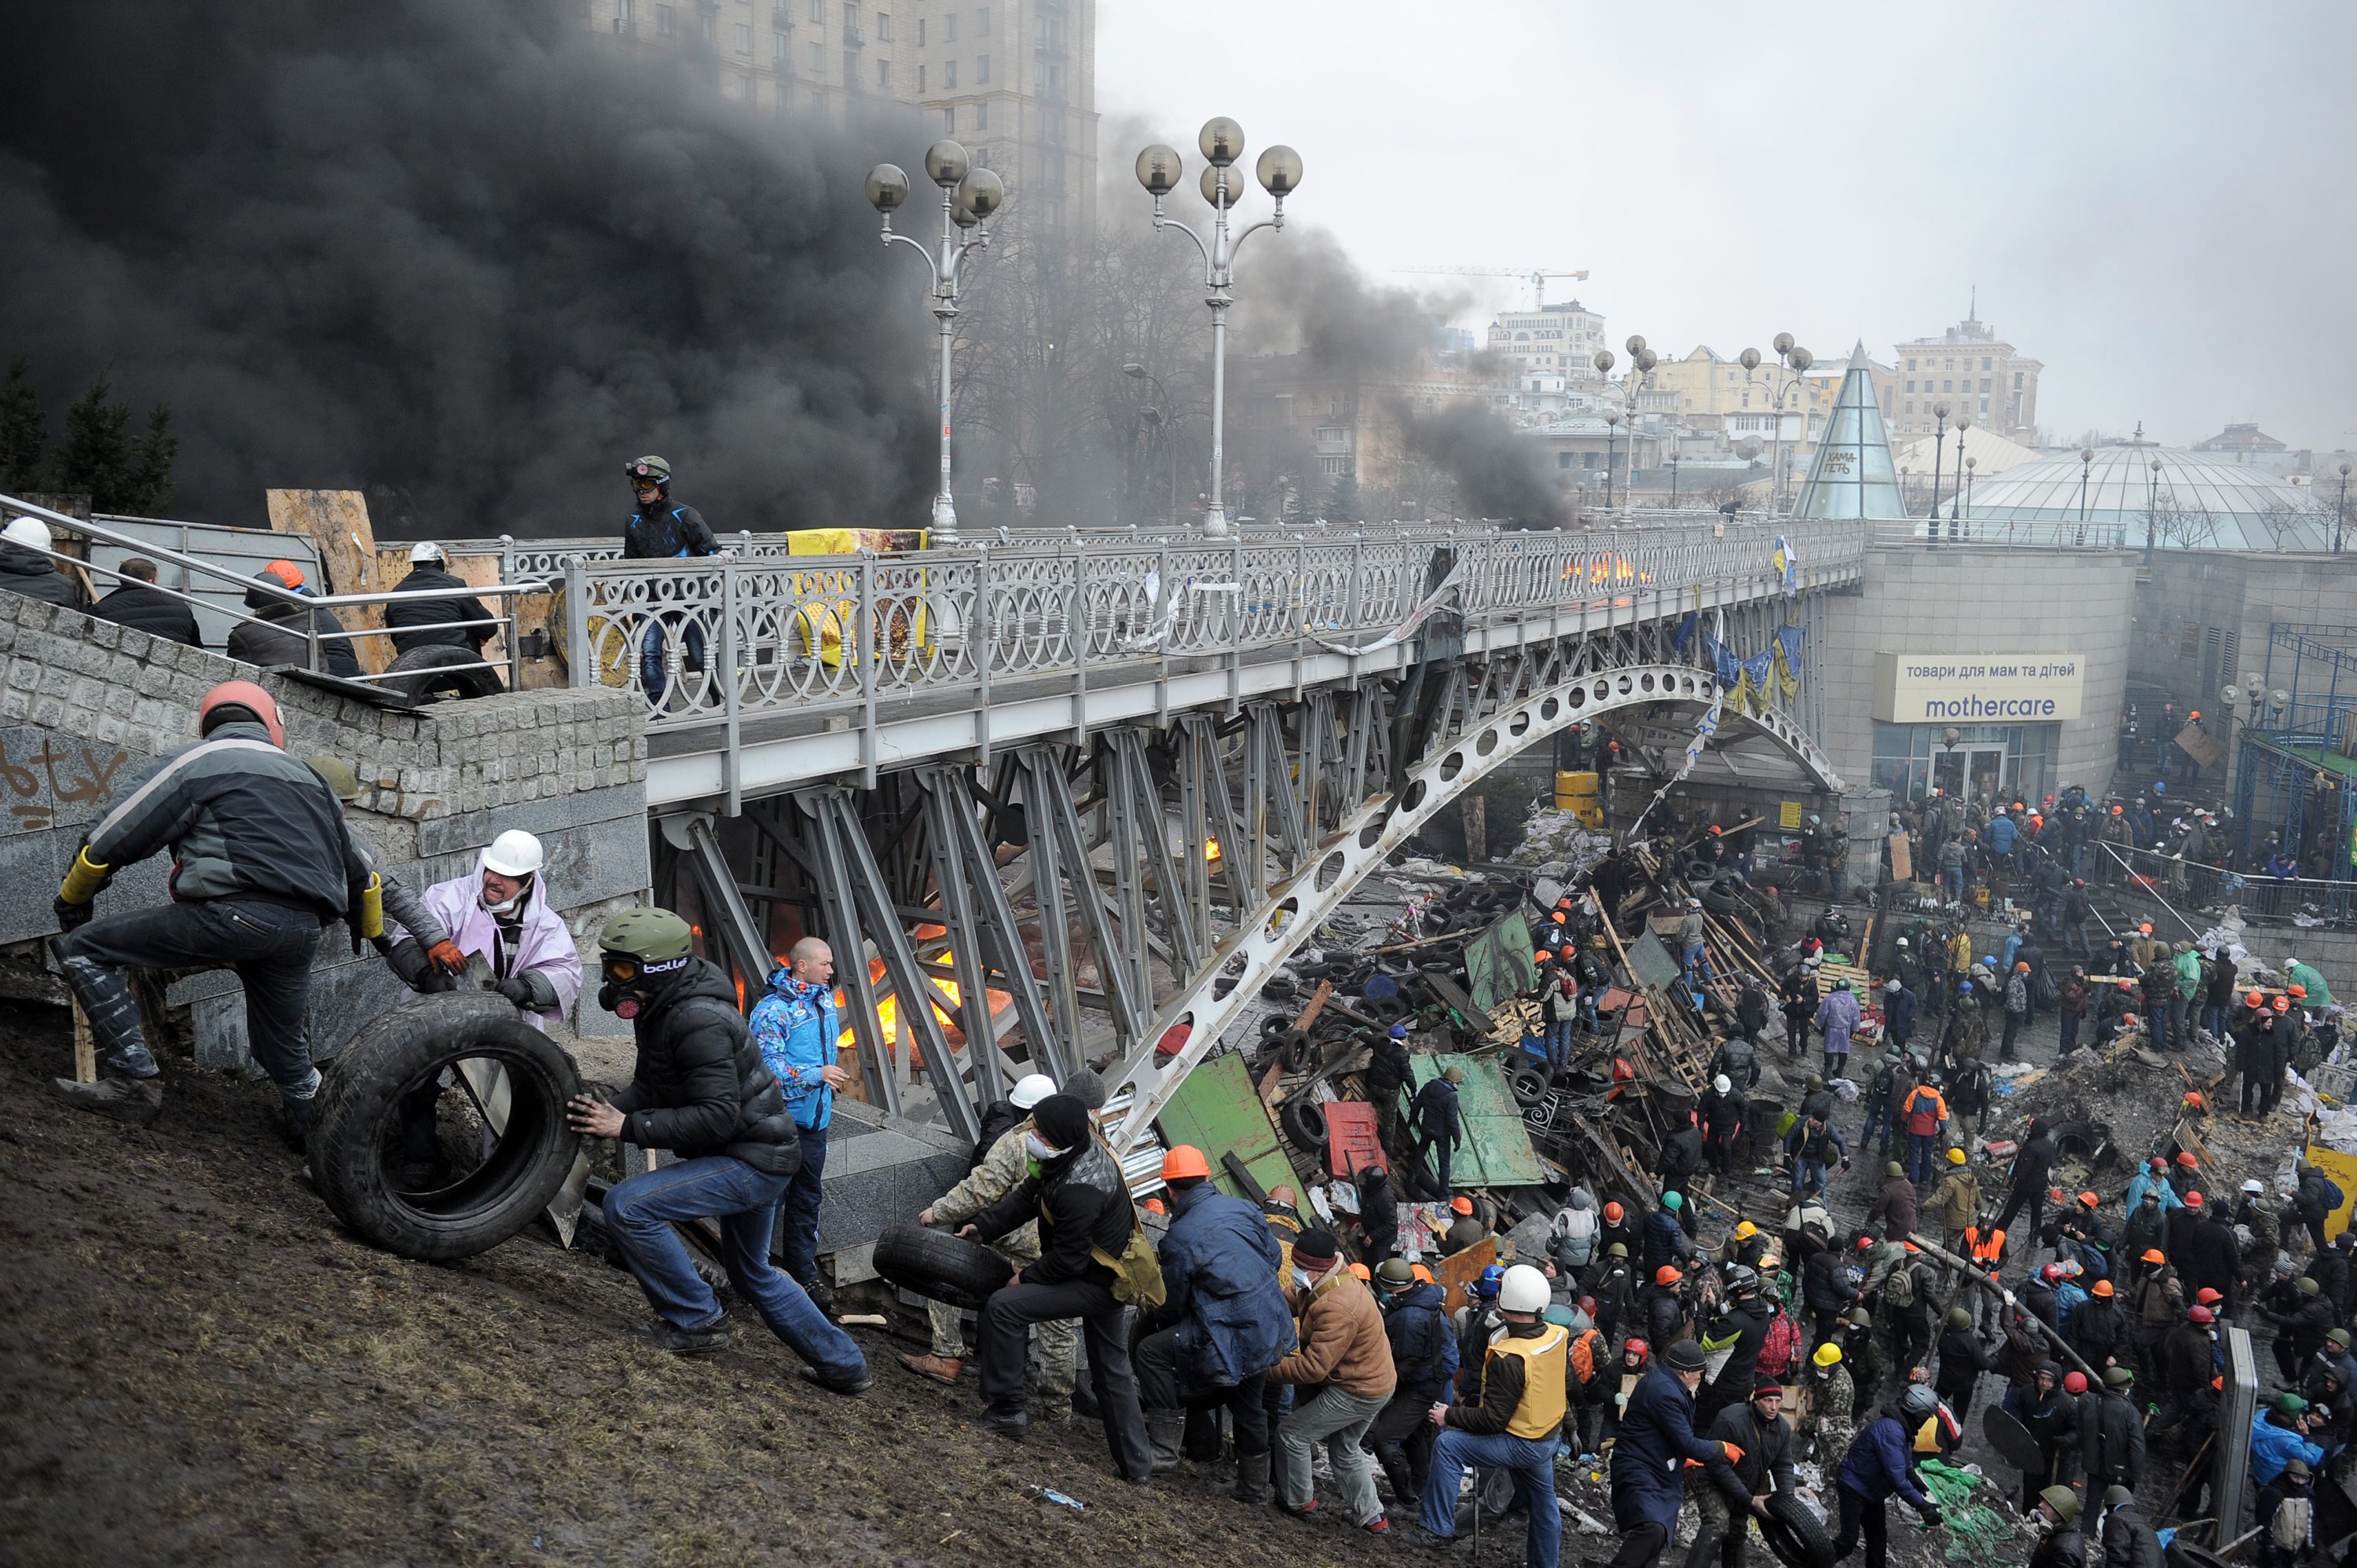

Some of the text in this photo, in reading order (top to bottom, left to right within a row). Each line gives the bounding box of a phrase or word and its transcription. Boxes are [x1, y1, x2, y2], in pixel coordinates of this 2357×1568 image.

[1824, 463, 1850, 474] ГЕТЬ
[1907, 662, 2075, 680] товари для мам та дітей
[1926, 694, 2055, 717] mothercare
[643, 957, 687, 973] bollé
